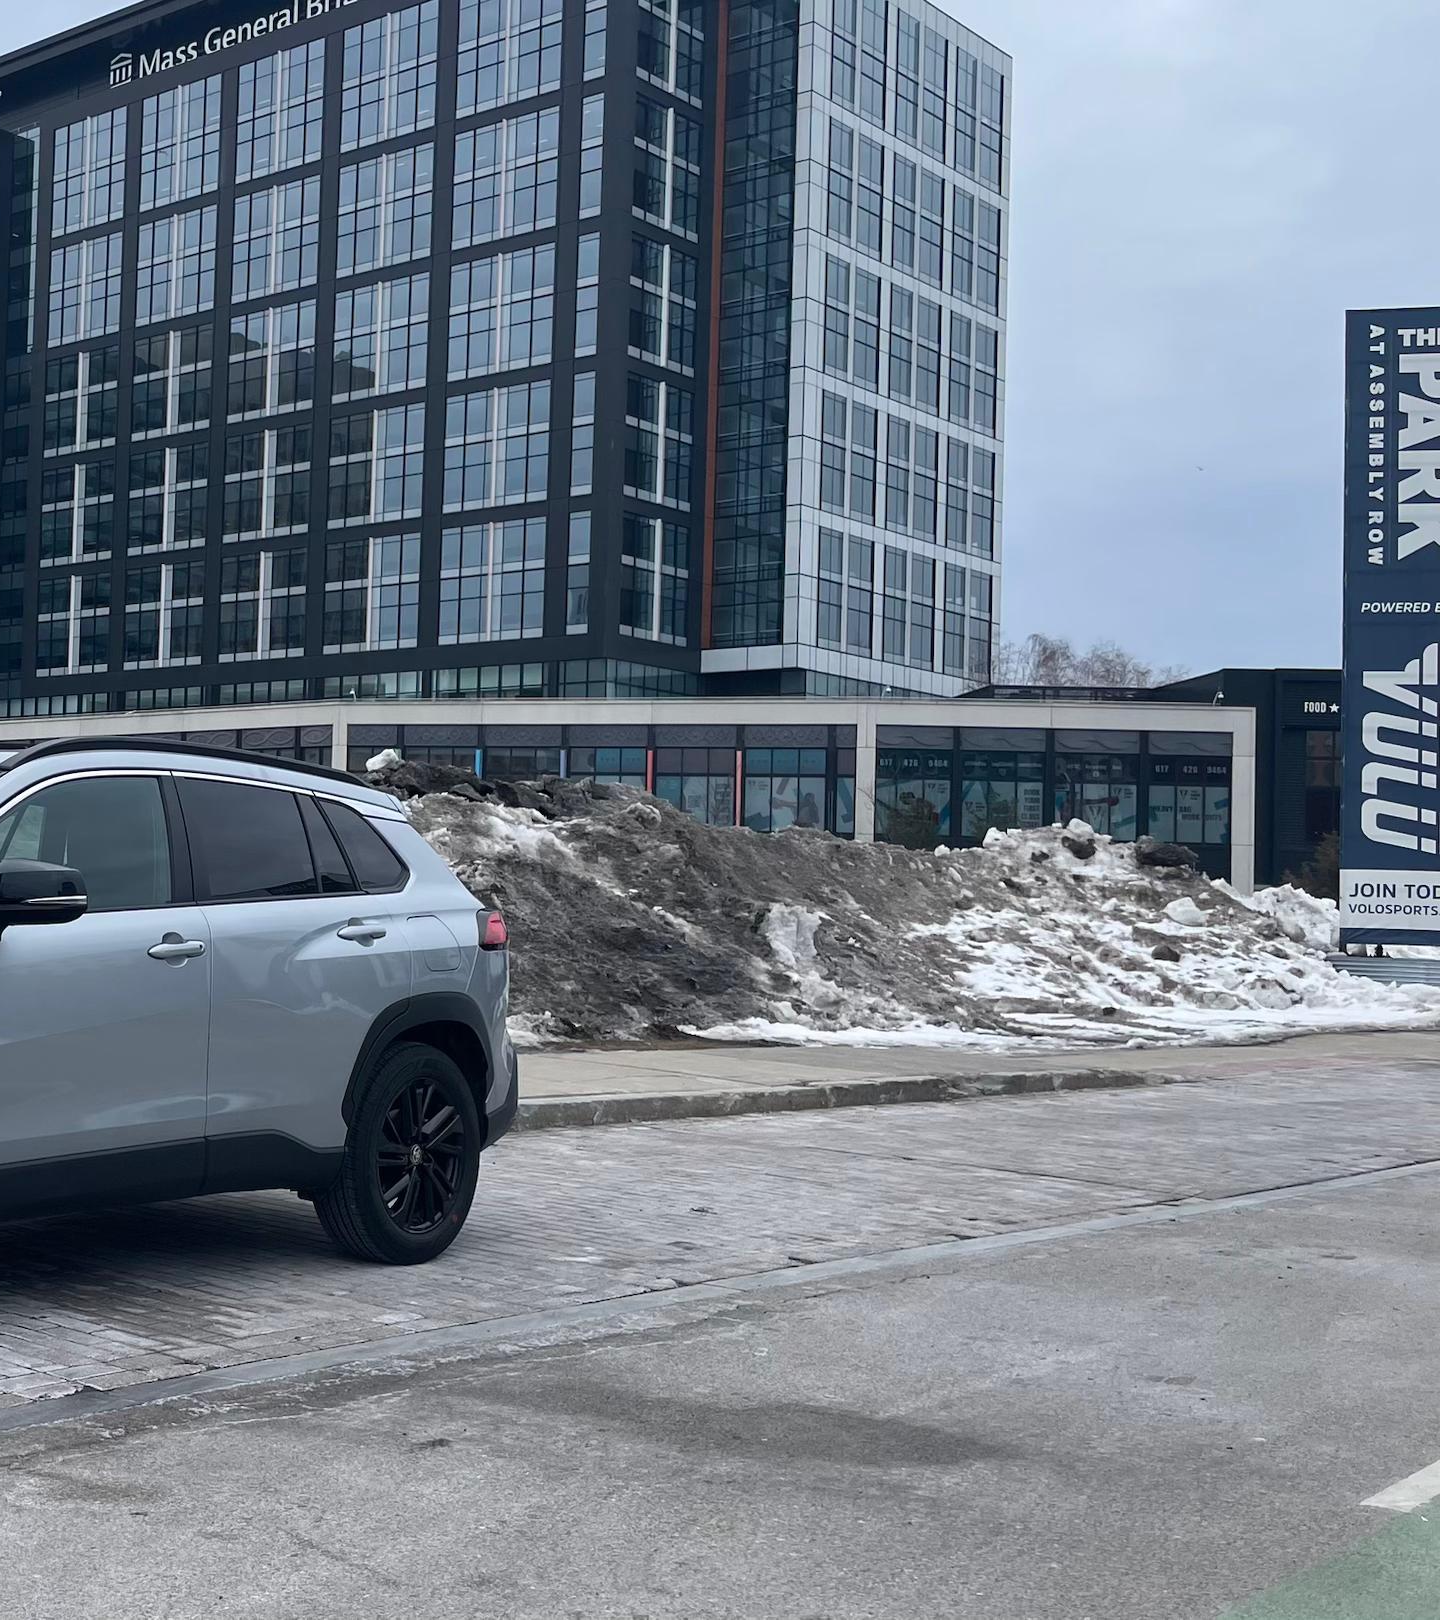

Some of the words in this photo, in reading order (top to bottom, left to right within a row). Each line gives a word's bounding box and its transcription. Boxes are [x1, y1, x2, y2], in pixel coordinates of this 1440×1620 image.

[139, 42, 198, 79] Mass
[203, 0, 299, 55] General
[1369, 325, 1385, 354] AT
[1398, 327, 1440, 347] TH
[1368, 364, 1385, 501] ASSEMBLY
[1398, 353, 1440, 561] PARK
[1368, 511, 1384, 565] ROW
[1361, 602, 1431, 613] POWERED
[1304, 702, 1327, 713] FOOD
[1349, 883, 1396, 898] JOIN
